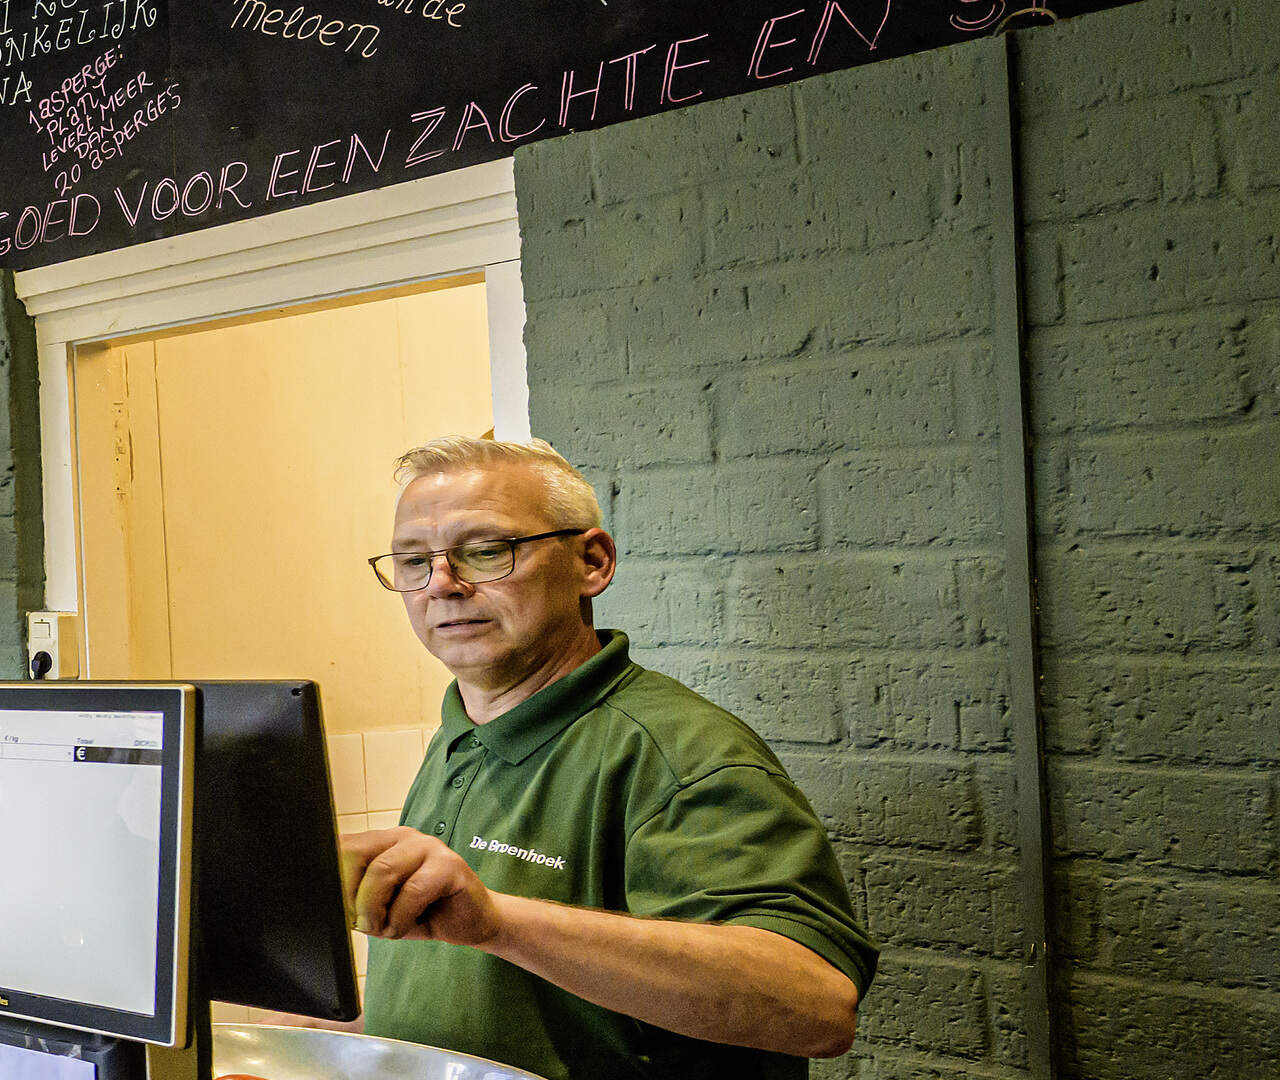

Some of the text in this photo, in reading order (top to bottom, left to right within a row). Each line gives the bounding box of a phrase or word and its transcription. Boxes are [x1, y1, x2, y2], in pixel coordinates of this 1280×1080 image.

[115, 160, 253, 228] VOOR
[267, 129, 391, 198] EEN
[403, 34, 710, 170] ZACHTE
[748, 0, 891, 80] EN
[74, 118, 115, 160] DAN
[54, 164, 82, 197] 20
[76, 747, 86, 760] €
[470, 836, 488, 850] De
